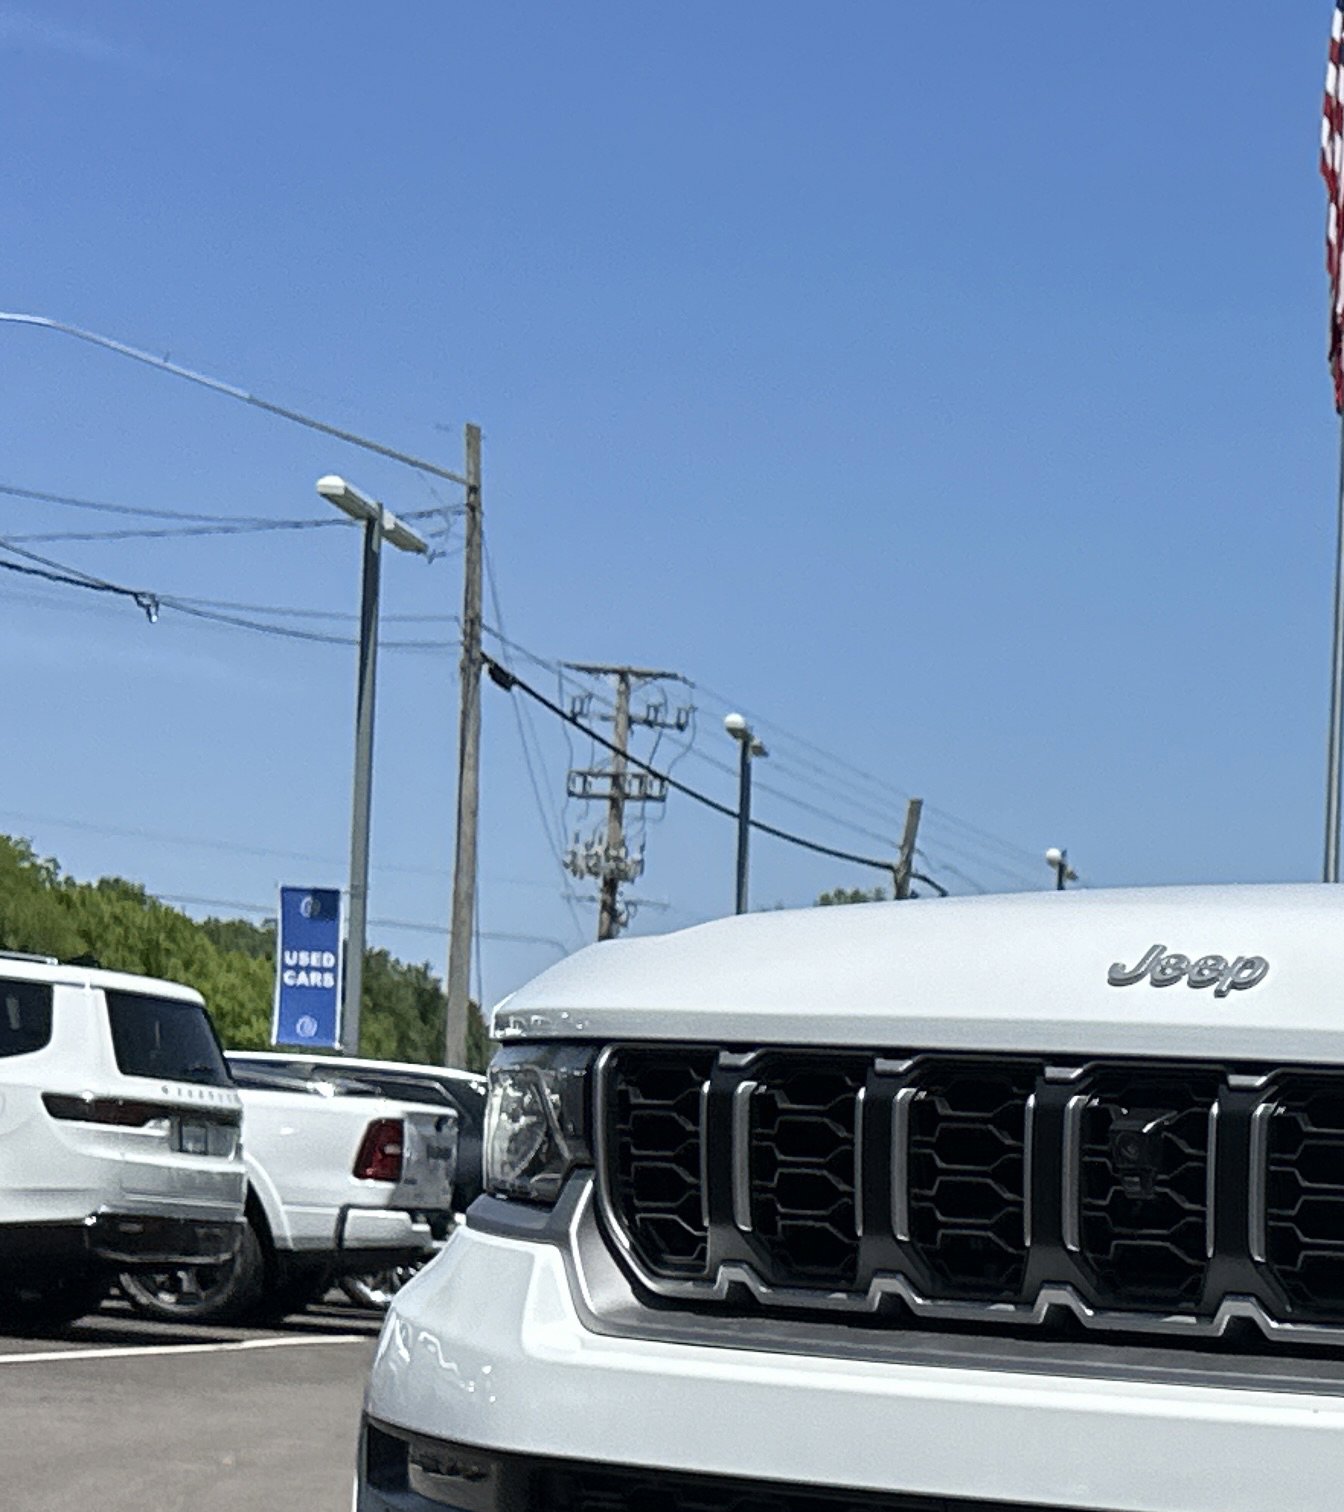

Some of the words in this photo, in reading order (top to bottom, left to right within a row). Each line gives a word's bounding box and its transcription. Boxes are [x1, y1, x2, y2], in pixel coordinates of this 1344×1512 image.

[284, 950, 336, 967] USED
[283, 970, 335, 988] CARS
[1107, 944, 1270, 998] Jeep
